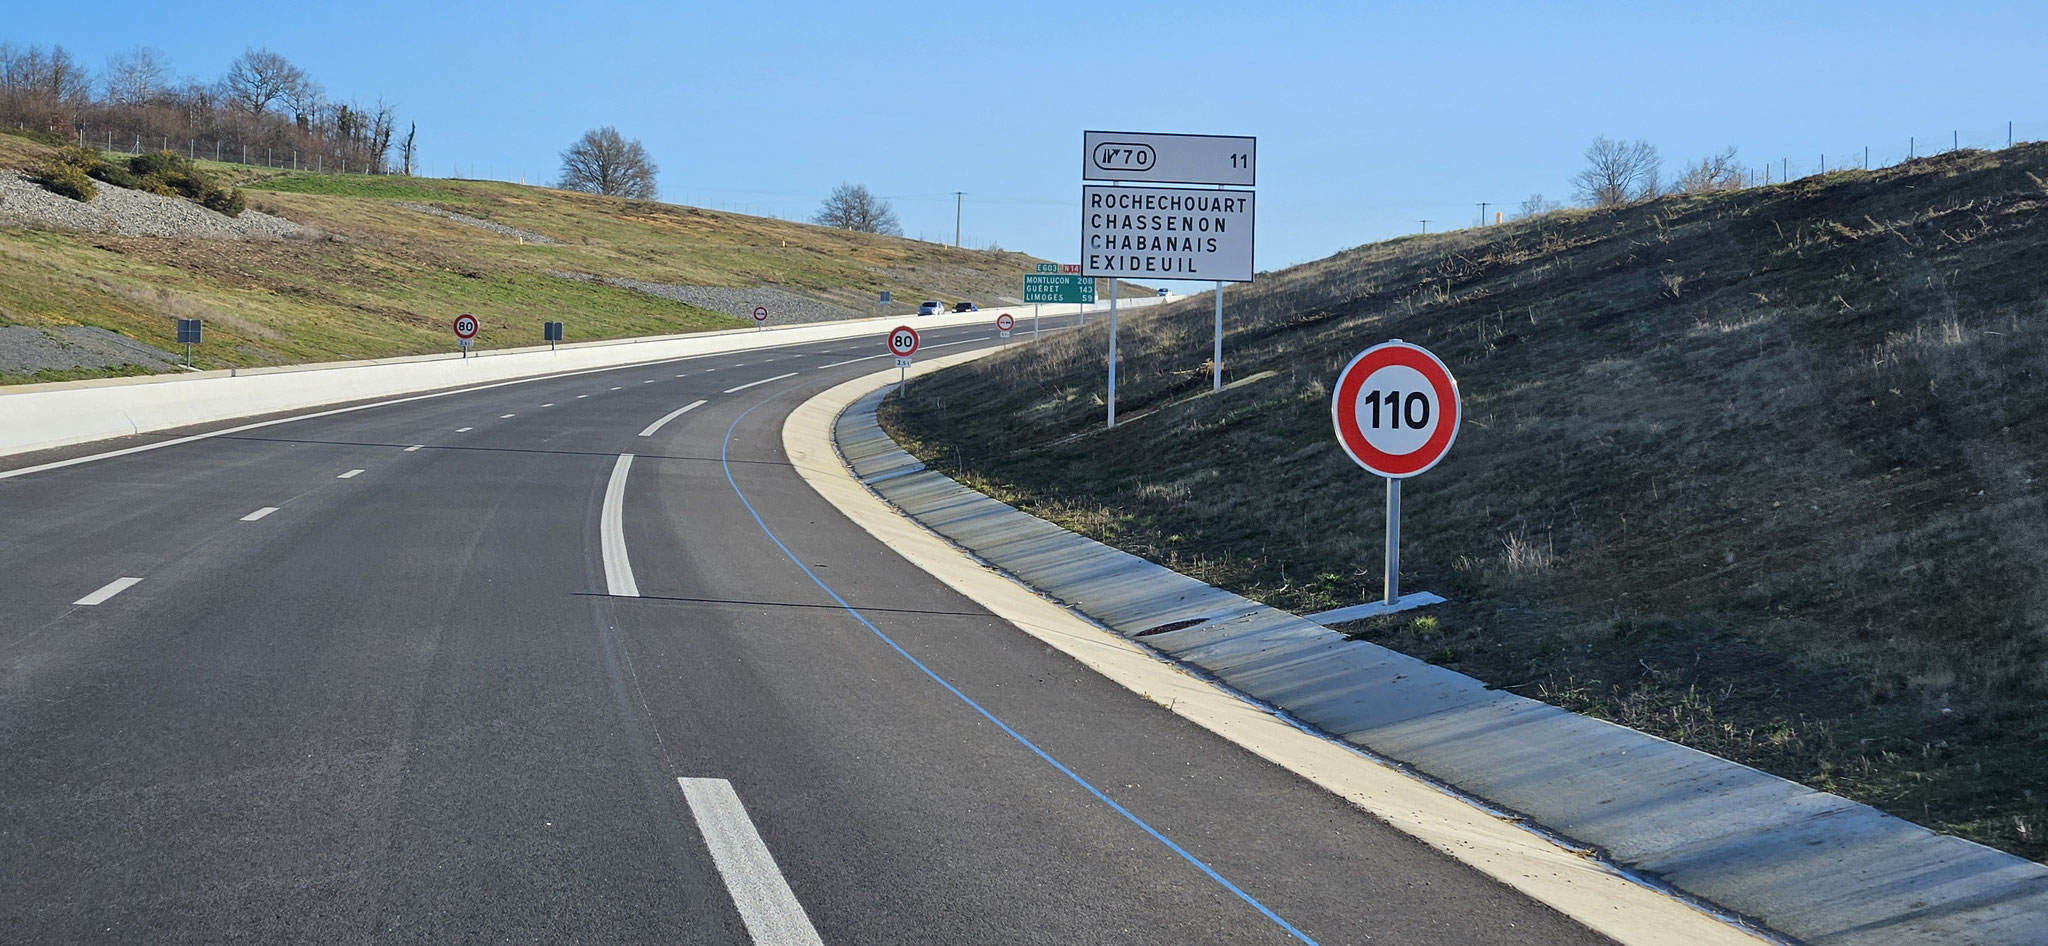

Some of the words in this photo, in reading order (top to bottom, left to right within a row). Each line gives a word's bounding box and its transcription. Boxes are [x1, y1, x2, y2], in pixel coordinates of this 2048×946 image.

[1123, 149, 1147, 165] 70
[1230, 153, 1248, 169] 11
[1091, 193, 1247, 213] ROCHECHOUART
[1091, 213, 1226, 233] CHASSENON
[1090, 234, 1218, 253] CHABANAIS
[1089, 254, 1198, 273] EXIDEUIL
[1026, 284, 1060, 293] GUÉRET
[1077, 277, 1093, 285] 208
[1026, 293, 1064, 301] LIMOGES
[1082, 294, 1093, 302] 59
[458, 322, 473, 332] 80
[894, 336, 912, 348] 80
[1364, 389, 1430, 430] 110
